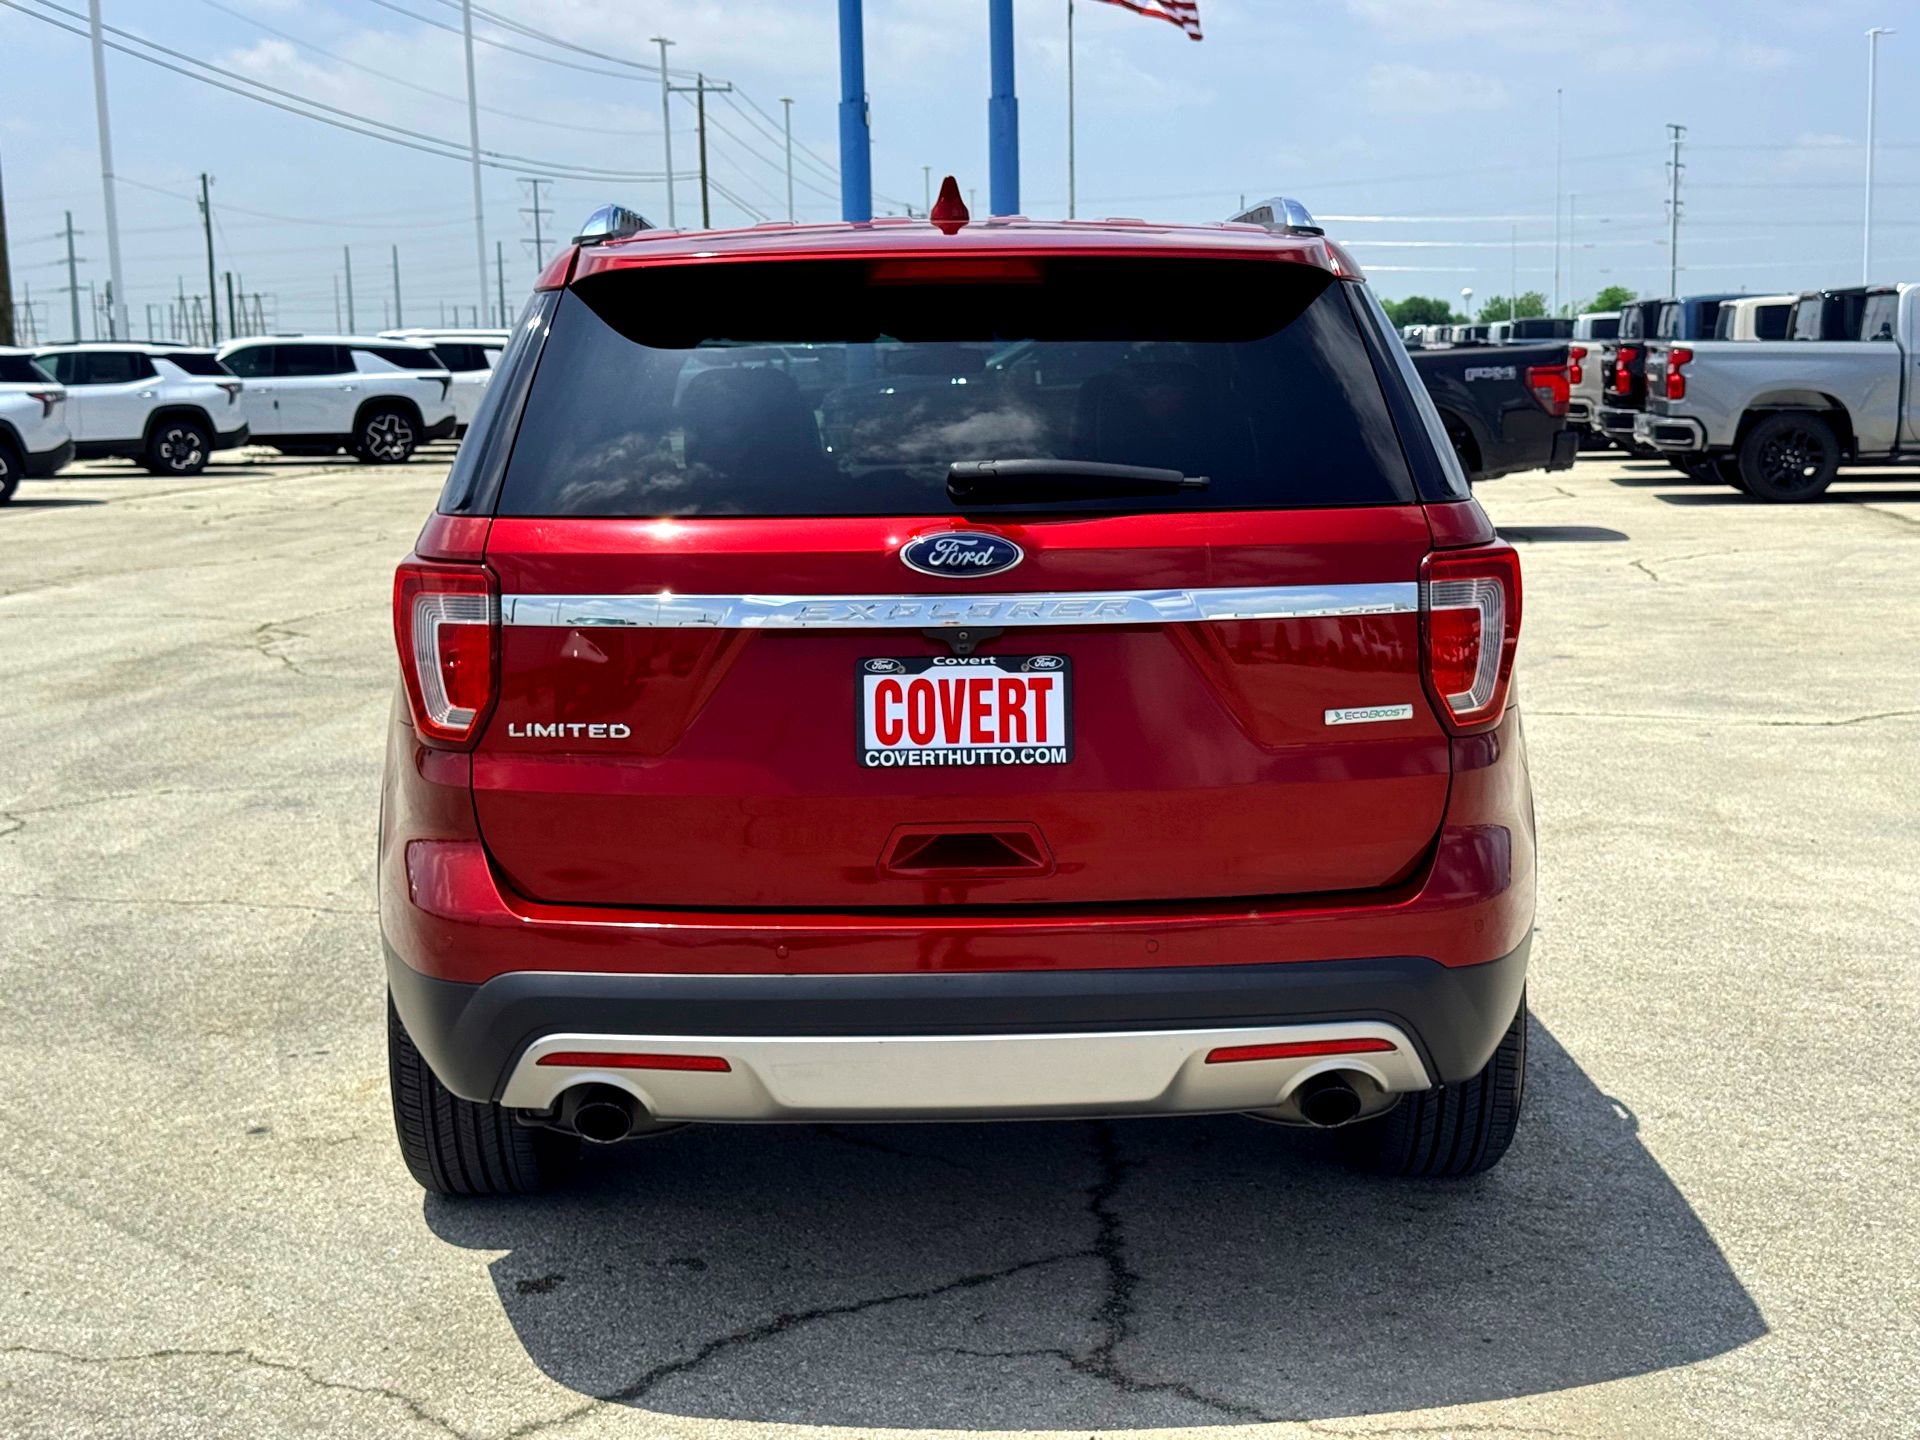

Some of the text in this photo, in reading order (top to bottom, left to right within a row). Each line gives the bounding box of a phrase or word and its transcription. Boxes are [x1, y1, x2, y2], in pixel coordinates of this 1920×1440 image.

[928, 539, 993, 566] Ford
[794, 600, 1131, 621] EXPLORER
[871, 660, 894, 670] Ford
[933, 656, 997, 666] Covert
[1034, 657, 1057, 667] Ford
[875, 677, 1053, 746] COVERT
[1344, 708, 1408, 720] ECOBOOST
[508, 723, 631, 739] LIMITED
[865, 748, 1067, 767] COVERTHUTTO.COM
